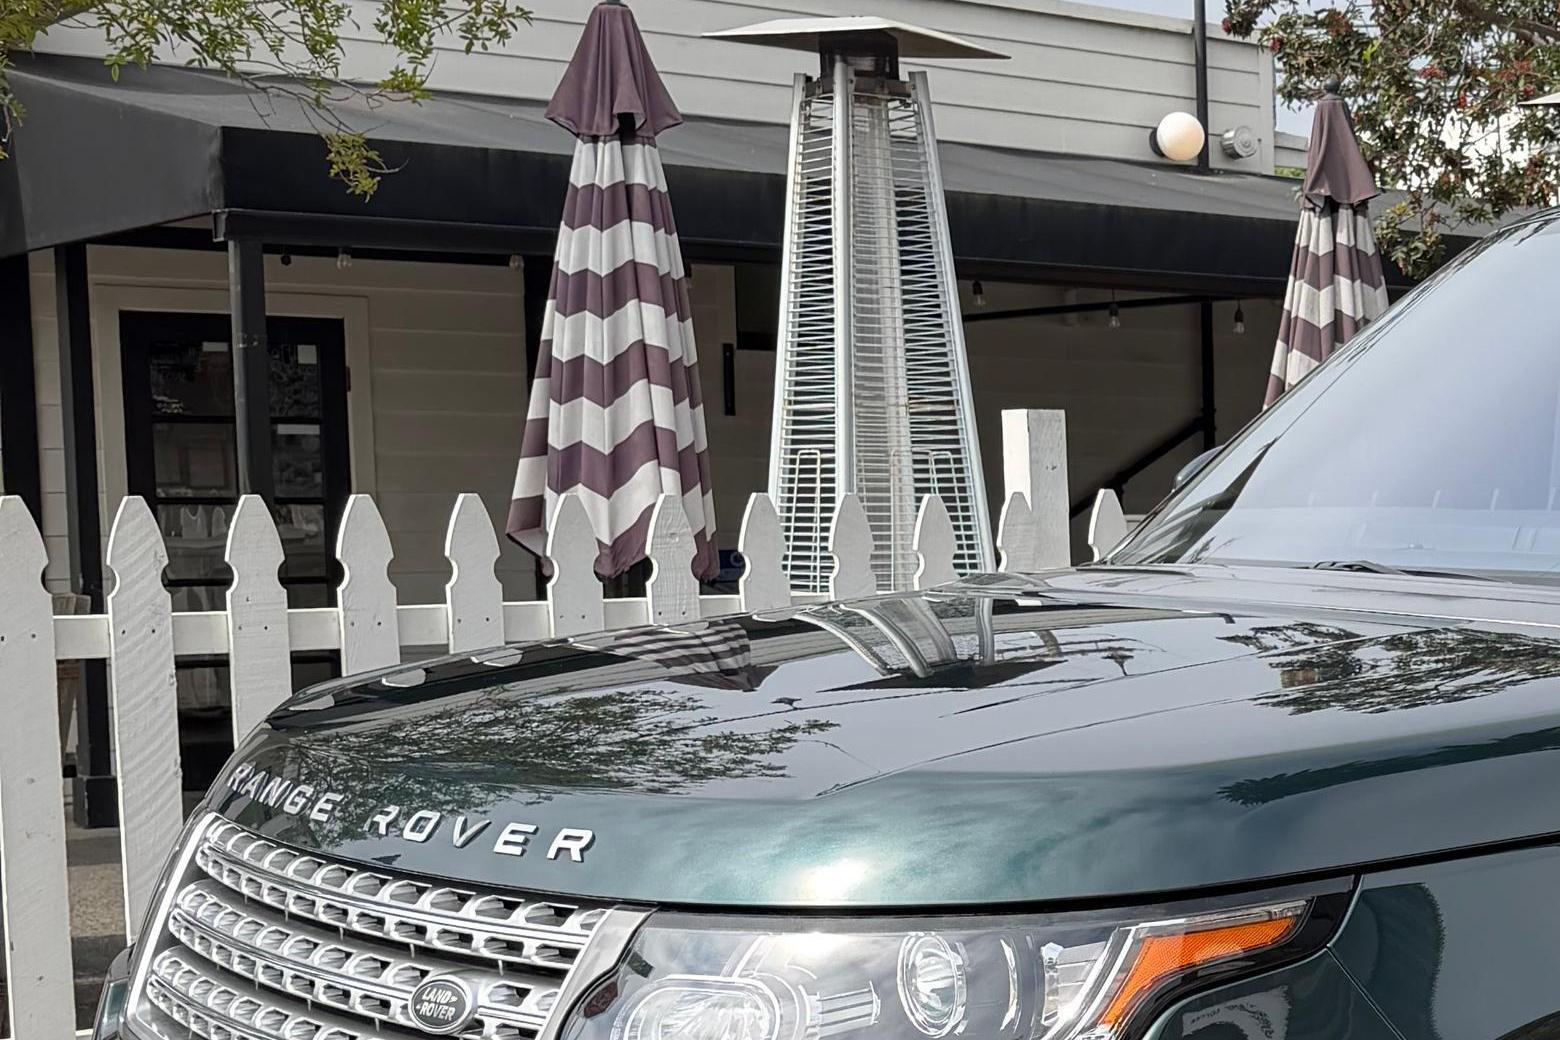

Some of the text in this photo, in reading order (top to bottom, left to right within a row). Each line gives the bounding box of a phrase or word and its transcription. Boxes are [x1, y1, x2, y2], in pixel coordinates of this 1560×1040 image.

[227, 761, 595, 863] RANGE ROVER
[422, 987, 452, 1004] LAND
[419, 1001, 456, 1021] ROVER
